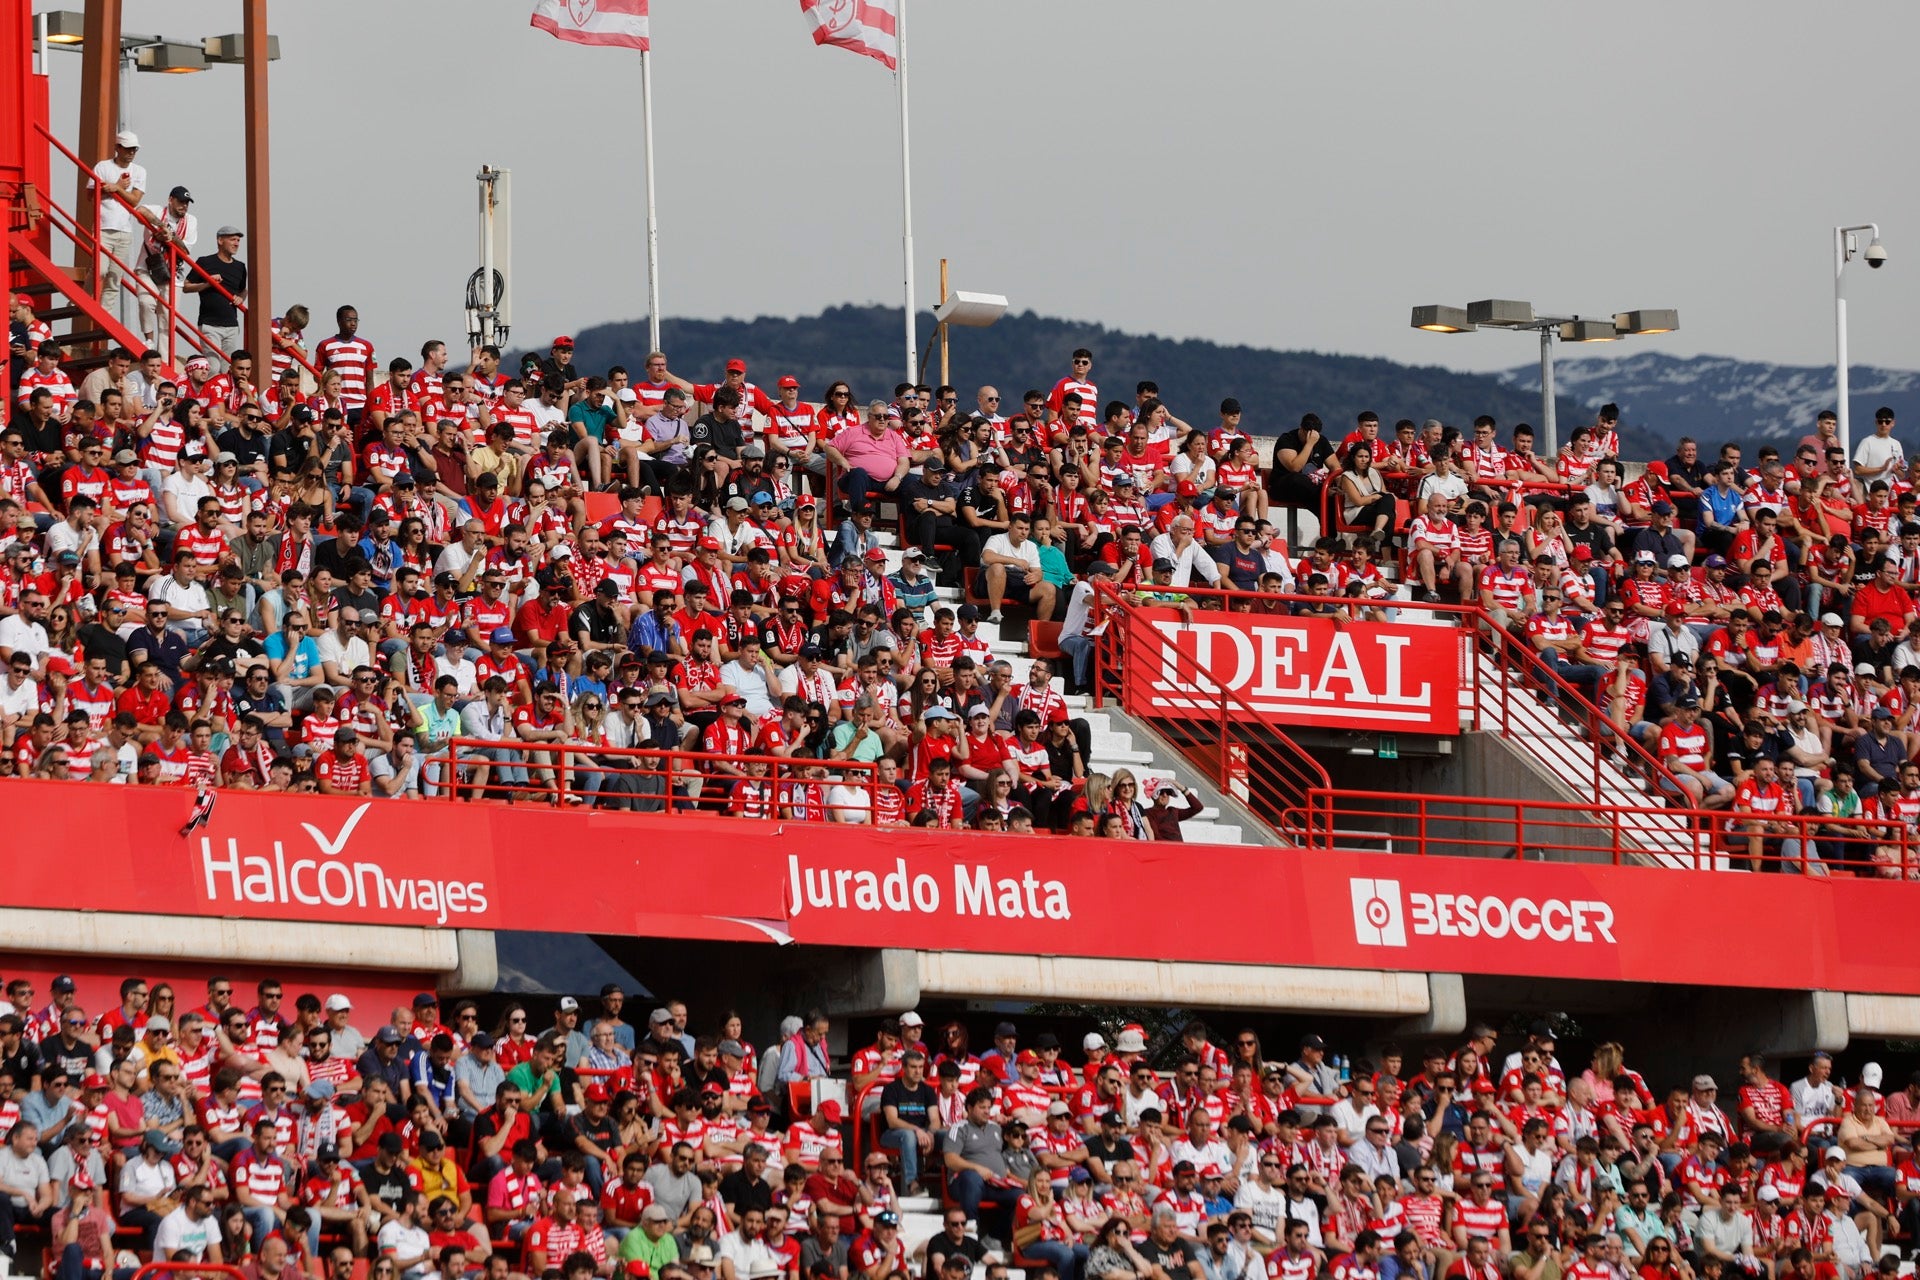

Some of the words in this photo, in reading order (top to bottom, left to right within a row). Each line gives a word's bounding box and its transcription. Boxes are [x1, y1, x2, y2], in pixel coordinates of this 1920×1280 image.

[1151, 620, 1431, 707] IDEAL
[788, 854, 940, 917] Jurado
[954, 864, 1071, 920] Mata
[1410, 892, 1617, 943] BESOCCER
